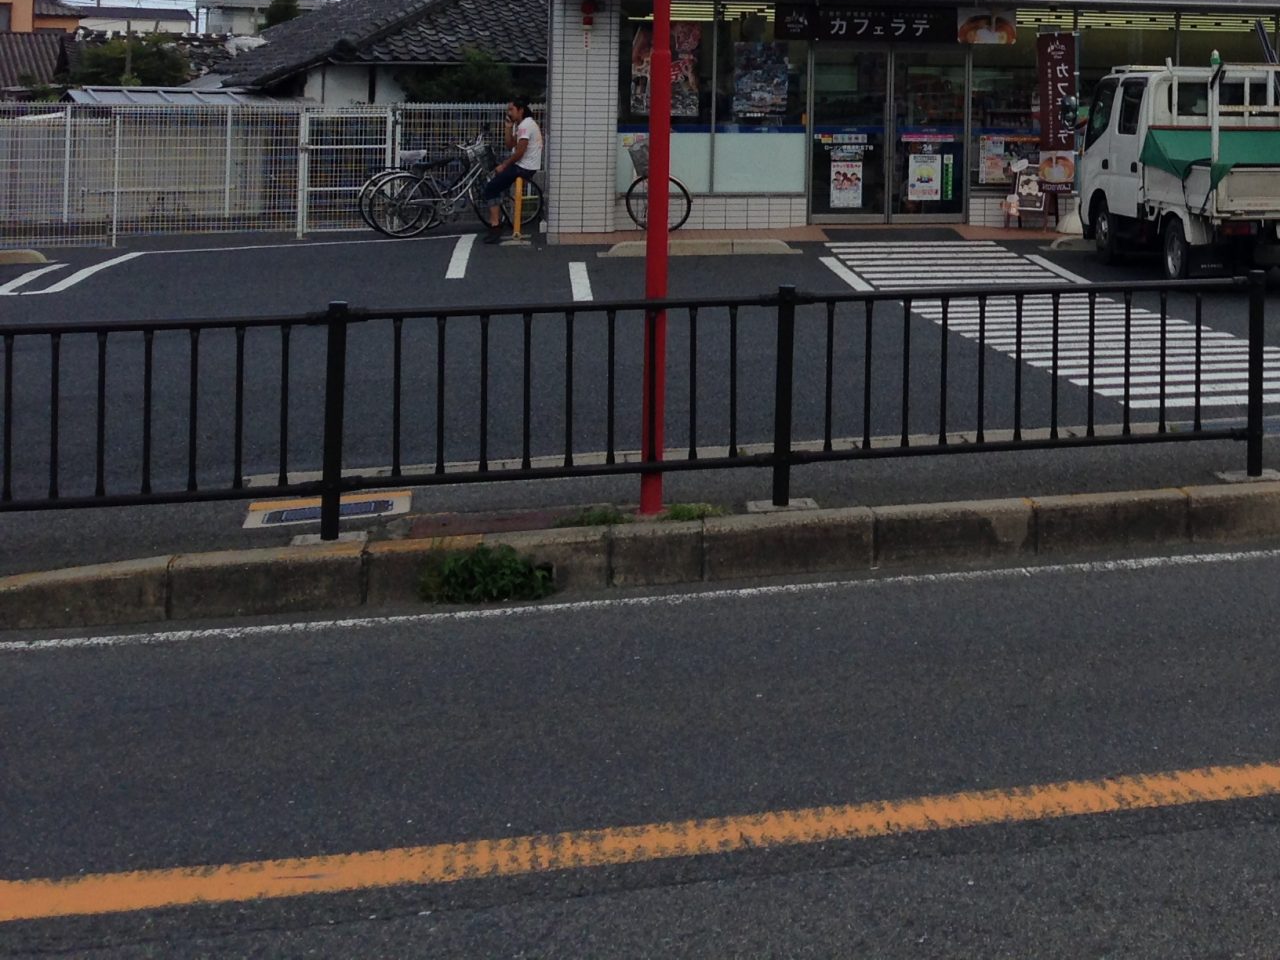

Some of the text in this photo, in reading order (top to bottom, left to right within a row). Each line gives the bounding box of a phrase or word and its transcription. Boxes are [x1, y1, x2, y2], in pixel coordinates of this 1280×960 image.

[829, 17, 931, 37] カフェラテ
